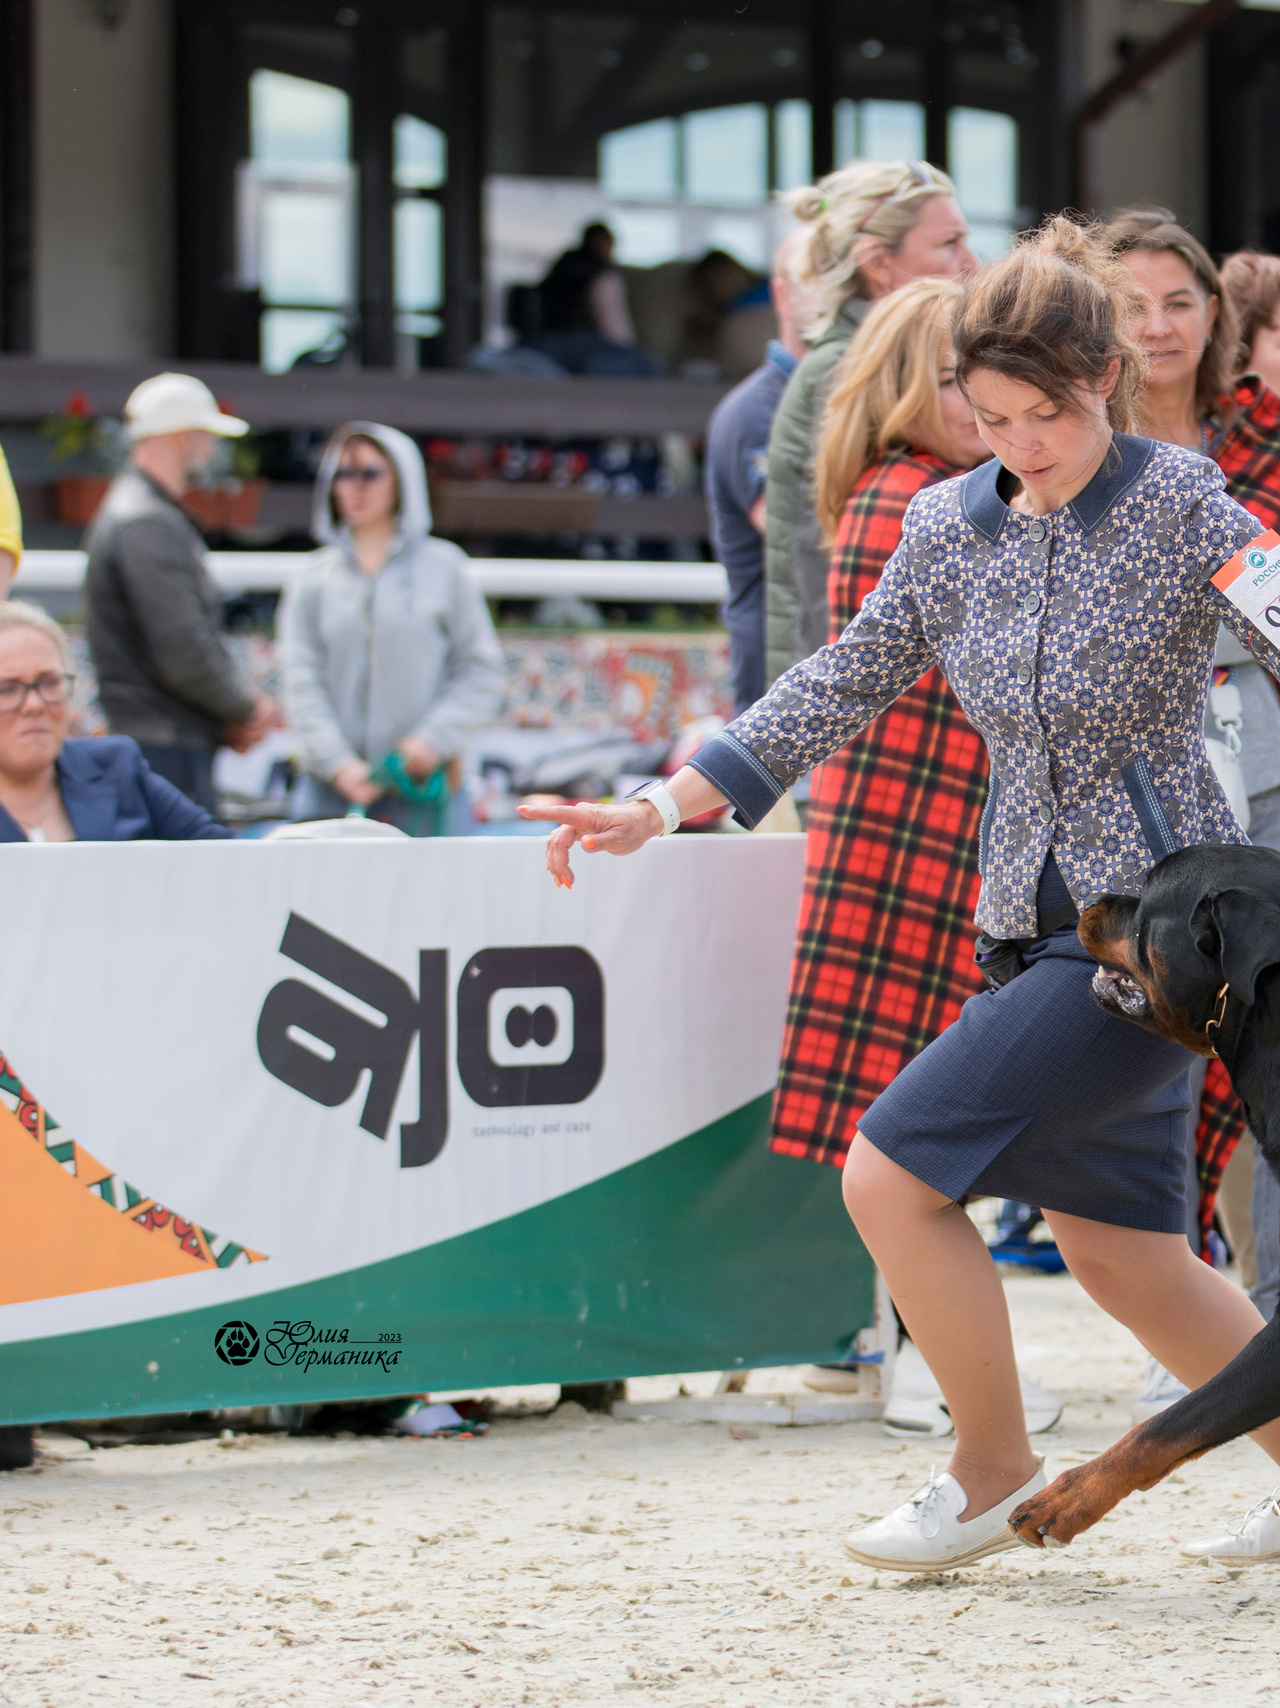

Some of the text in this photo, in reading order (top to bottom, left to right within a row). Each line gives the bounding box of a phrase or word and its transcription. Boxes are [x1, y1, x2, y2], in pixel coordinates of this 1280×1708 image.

[472, 1120, 592, 1138] technology and care
